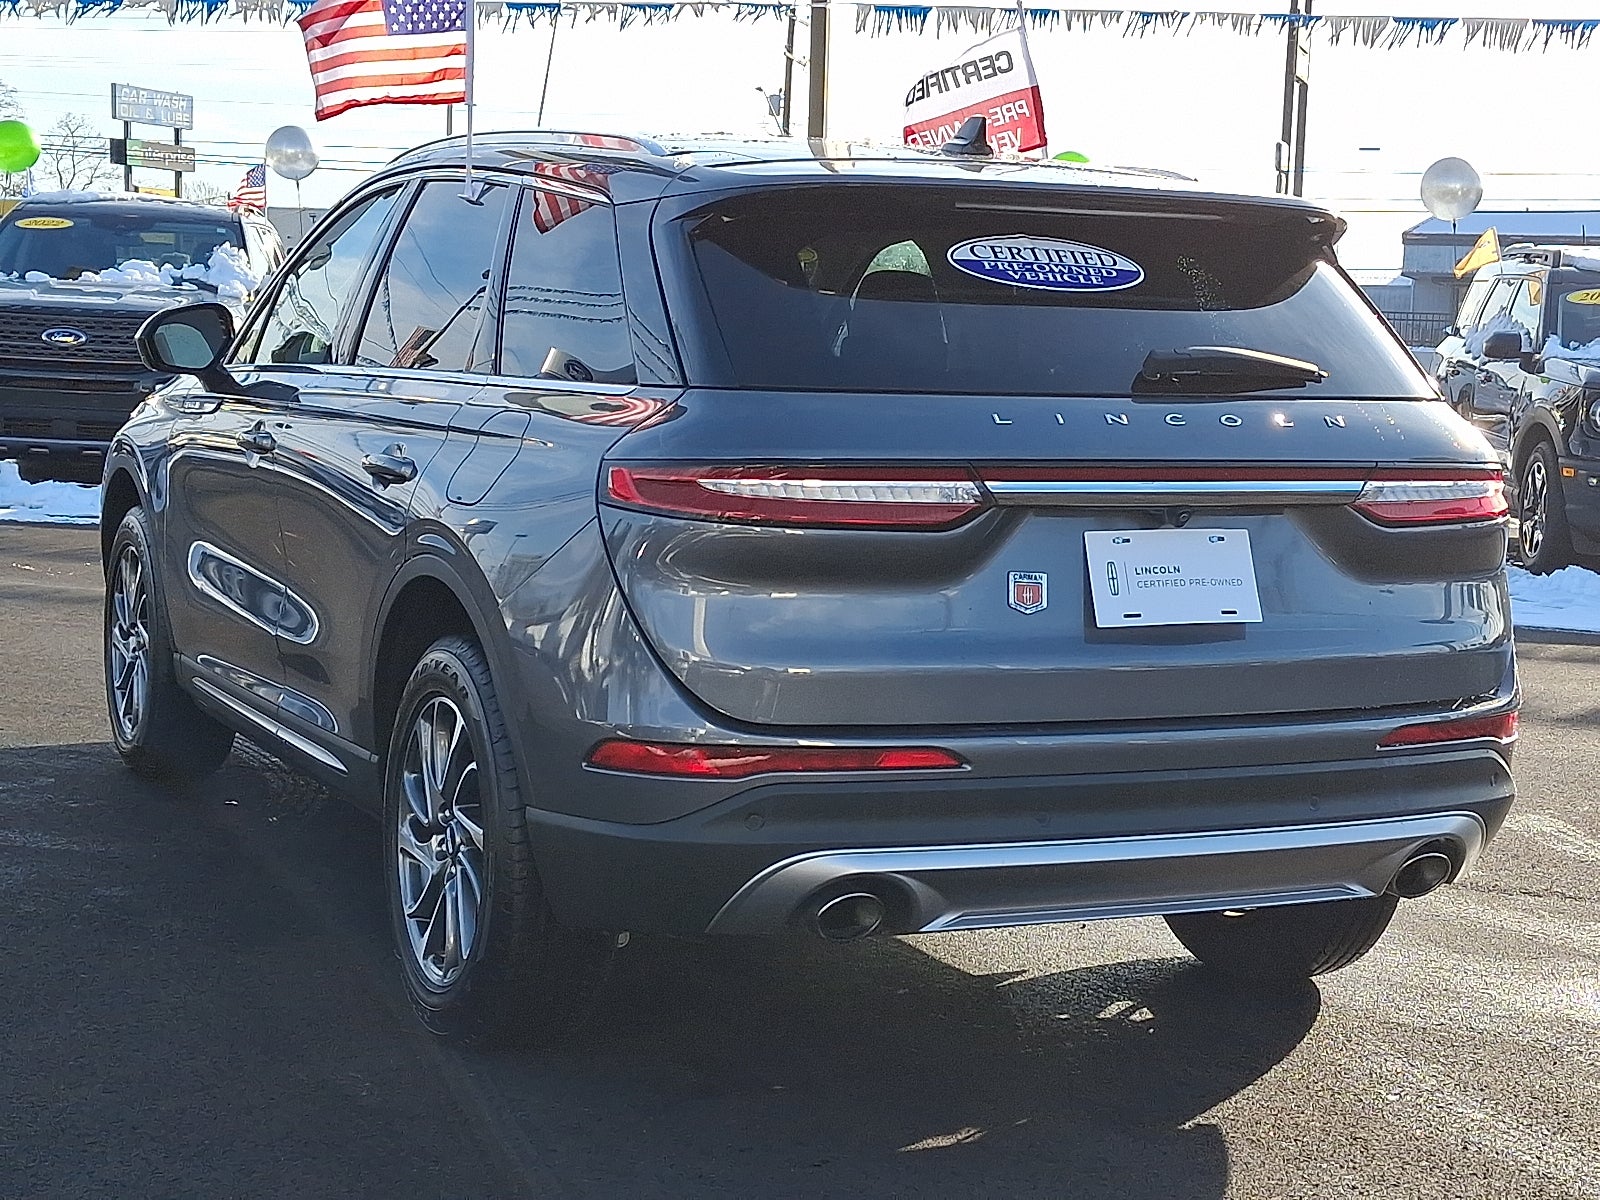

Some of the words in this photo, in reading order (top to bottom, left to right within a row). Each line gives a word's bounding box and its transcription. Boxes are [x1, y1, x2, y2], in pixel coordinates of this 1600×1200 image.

[121, 87, 148, 105] CAR
[153, 92, 188, 112] WASH
[120, 104, 139, 118] OIL
[145, 107, 155, 120] &
[161, 109, 190, 126] LUBE
[131, 145, 195, 166] enterprise
[968, 244, 1118, 267] CERTIFIED
[980, 260, 1118, 278] PRE-OWNED
[1006, 270, 1105, 285] VEHICLE
[991, 412, 1347, 428] LINCOLN
[1013, 573, 1043, 581] CARMAN
[1134, 565, 1181, 576] LINCOLN
[1136, 578, 1186, 589] CERTIFIED
[1189, 578, 1243, 588] PRE-OWNED
